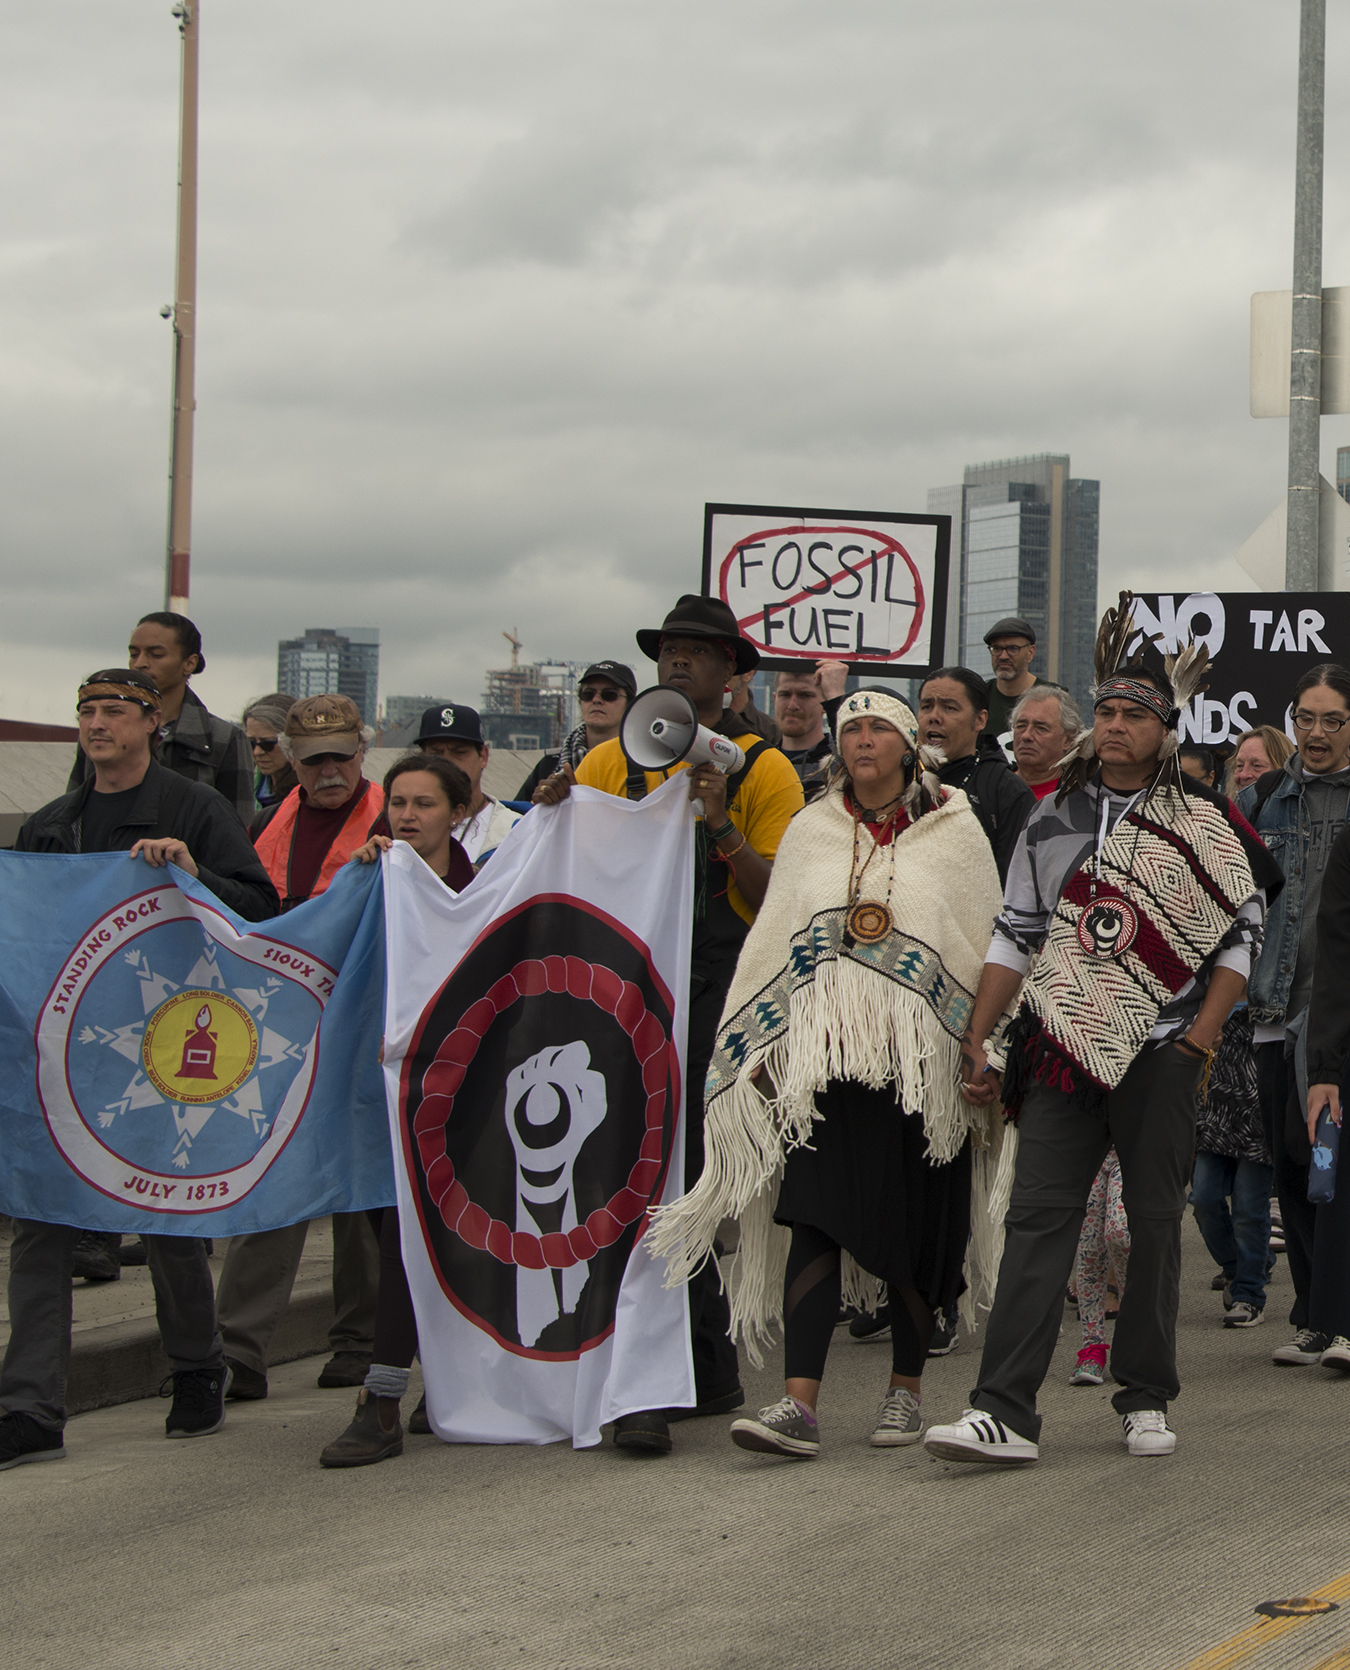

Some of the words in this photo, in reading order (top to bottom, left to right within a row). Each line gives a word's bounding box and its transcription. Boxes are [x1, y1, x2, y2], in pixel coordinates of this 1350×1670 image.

[737, 540, 920, 607] FOSSIL
[763, 602, 891, 656] FUEL
[1127, 591, 1227, 660] NO
[1250, 609, 1333, 654] TAR
[1178, 691, 1258, 746] NDS
[53, 929, 112, 1015] STANDING
[112, 897, 162, 932] ROCK
[263, 948, 316, 978] SIOUX
[151, 997, 180, 1026] PORCUPINE
[182, 990, 199, 999] LONG
[200, 990, 226, 1000] SOLDIER
[226, 999, 249, 1019] CANNON
[246, 1016, 256, 1034] BALL
[156, 1082, 178, 1099] SOLDIER
[206, 1086, 235, 1102] ANTELOPE
[124, 1176, 177, 1199] JULY
[186, 1181, 230, 1201] 1873
